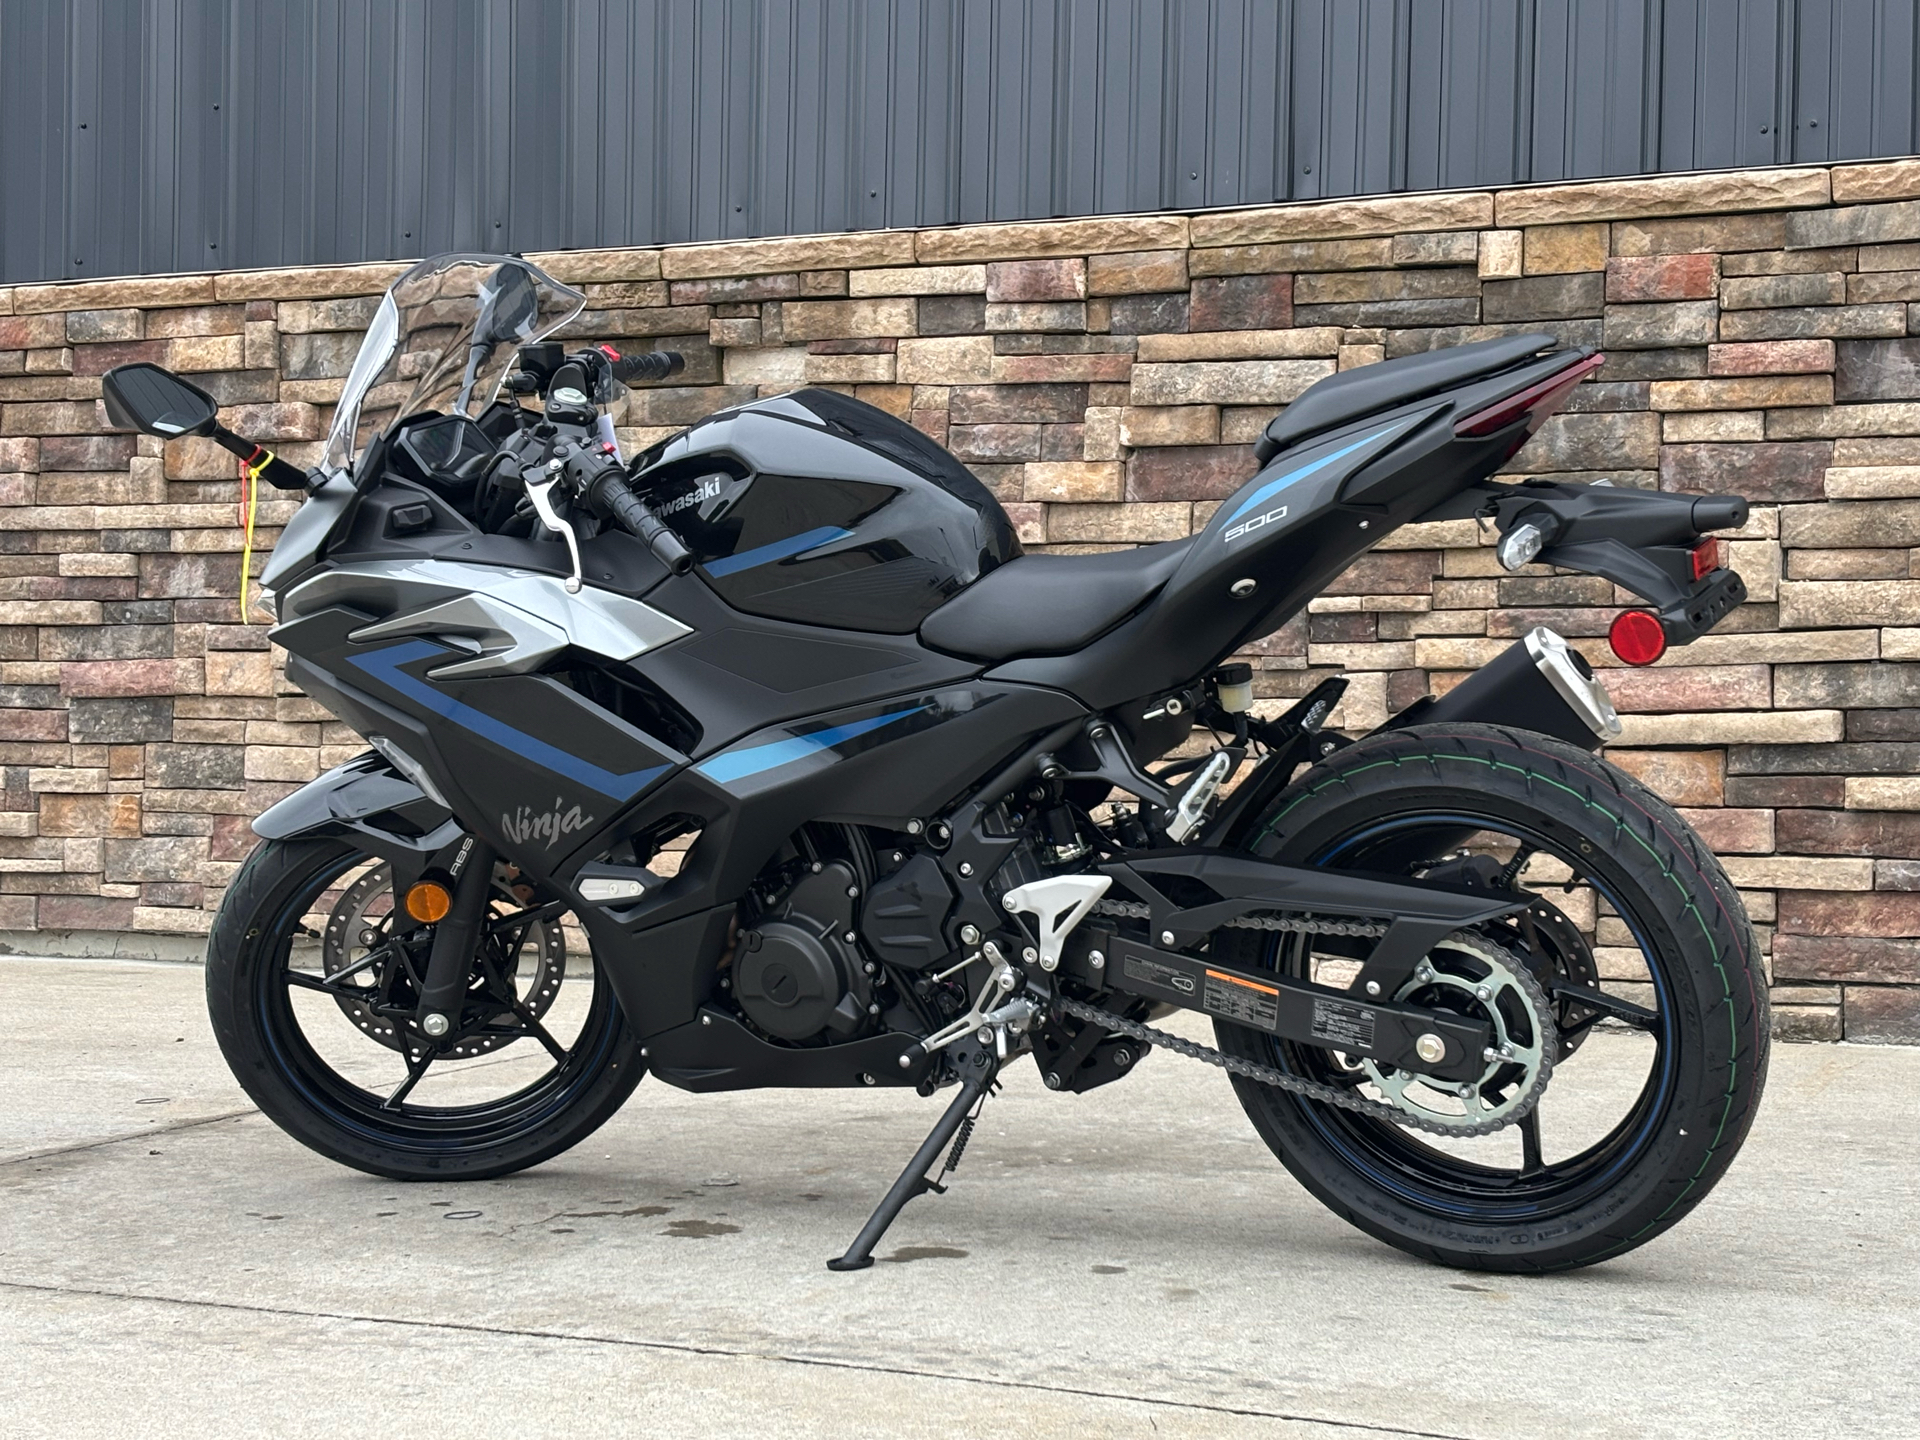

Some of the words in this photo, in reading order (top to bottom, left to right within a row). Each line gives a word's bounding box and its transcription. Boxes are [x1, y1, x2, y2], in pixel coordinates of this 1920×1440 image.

[649, 477, 720, 519] awasaki
[1224, 505, 1288, 543] 500
[502, 796, 594, 851] Ninja
[449, 837, 474, 876] ABS
